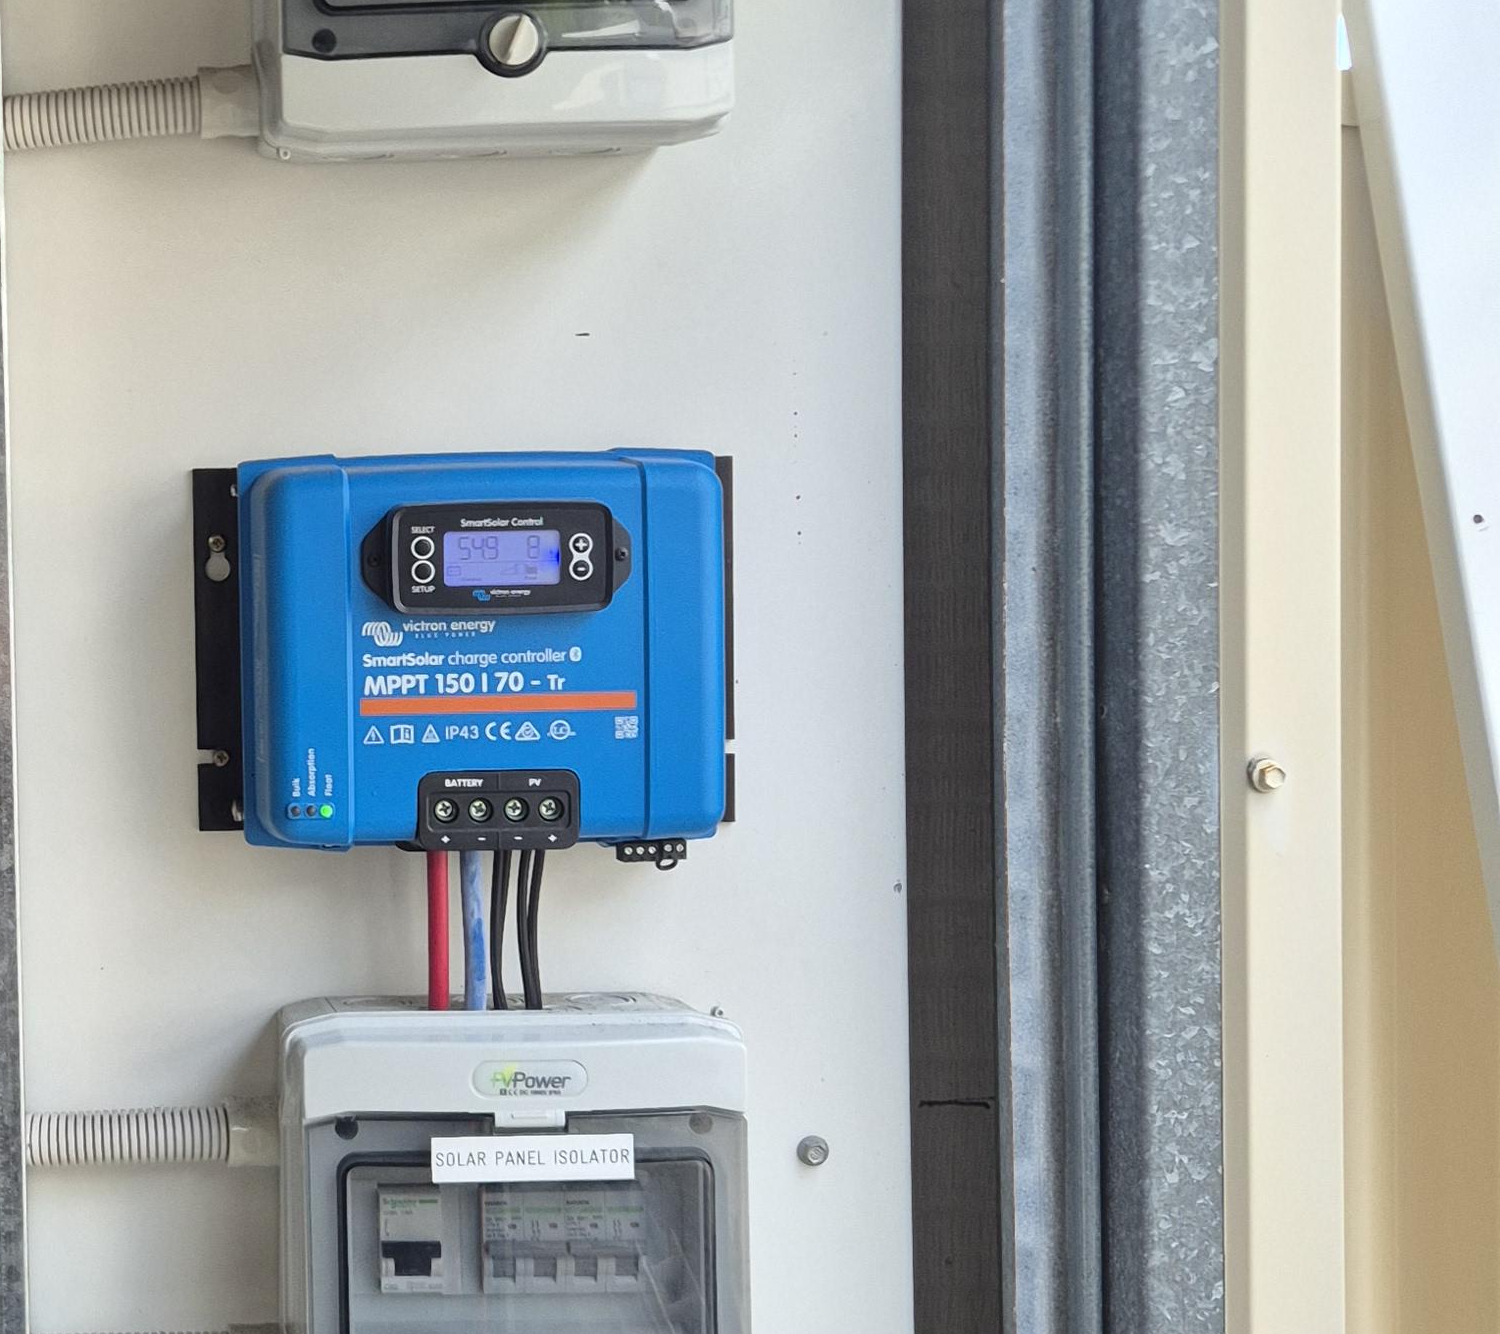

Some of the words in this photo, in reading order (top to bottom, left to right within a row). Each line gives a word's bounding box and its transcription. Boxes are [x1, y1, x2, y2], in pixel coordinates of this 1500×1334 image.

[460, 518, 509, 527] SmartSolar
[511, 517, 543, 526] Control
[403, 620, 447, 632] victron
[450, 620, 496, 633] energy
[362, 652, 445, 667] SmartSolar
[448, 651, 497, 667] charge
[501, 648, 566, 664] controller
[364, 675, 429, 695] MPPT
[436, 673, 475, 694] 150
[494, 672, 524, 692] 70
[547, 675, 565, 690] Tr
[446, 726, 479, 740] IP43
[307, 748, 315, 796] Absorption
[292, 778, 300, 797] Bulk
[324, 774, 332, 796] Float
[445, 779, 483, 788] BATTERY
[528, 778, 541, 787] PV
[436, 1152, 486, 1167] SOLAR
[496, 1151, 545, 1166] PANEL
[555, 1149, 630, 1164] ISOLATOR
